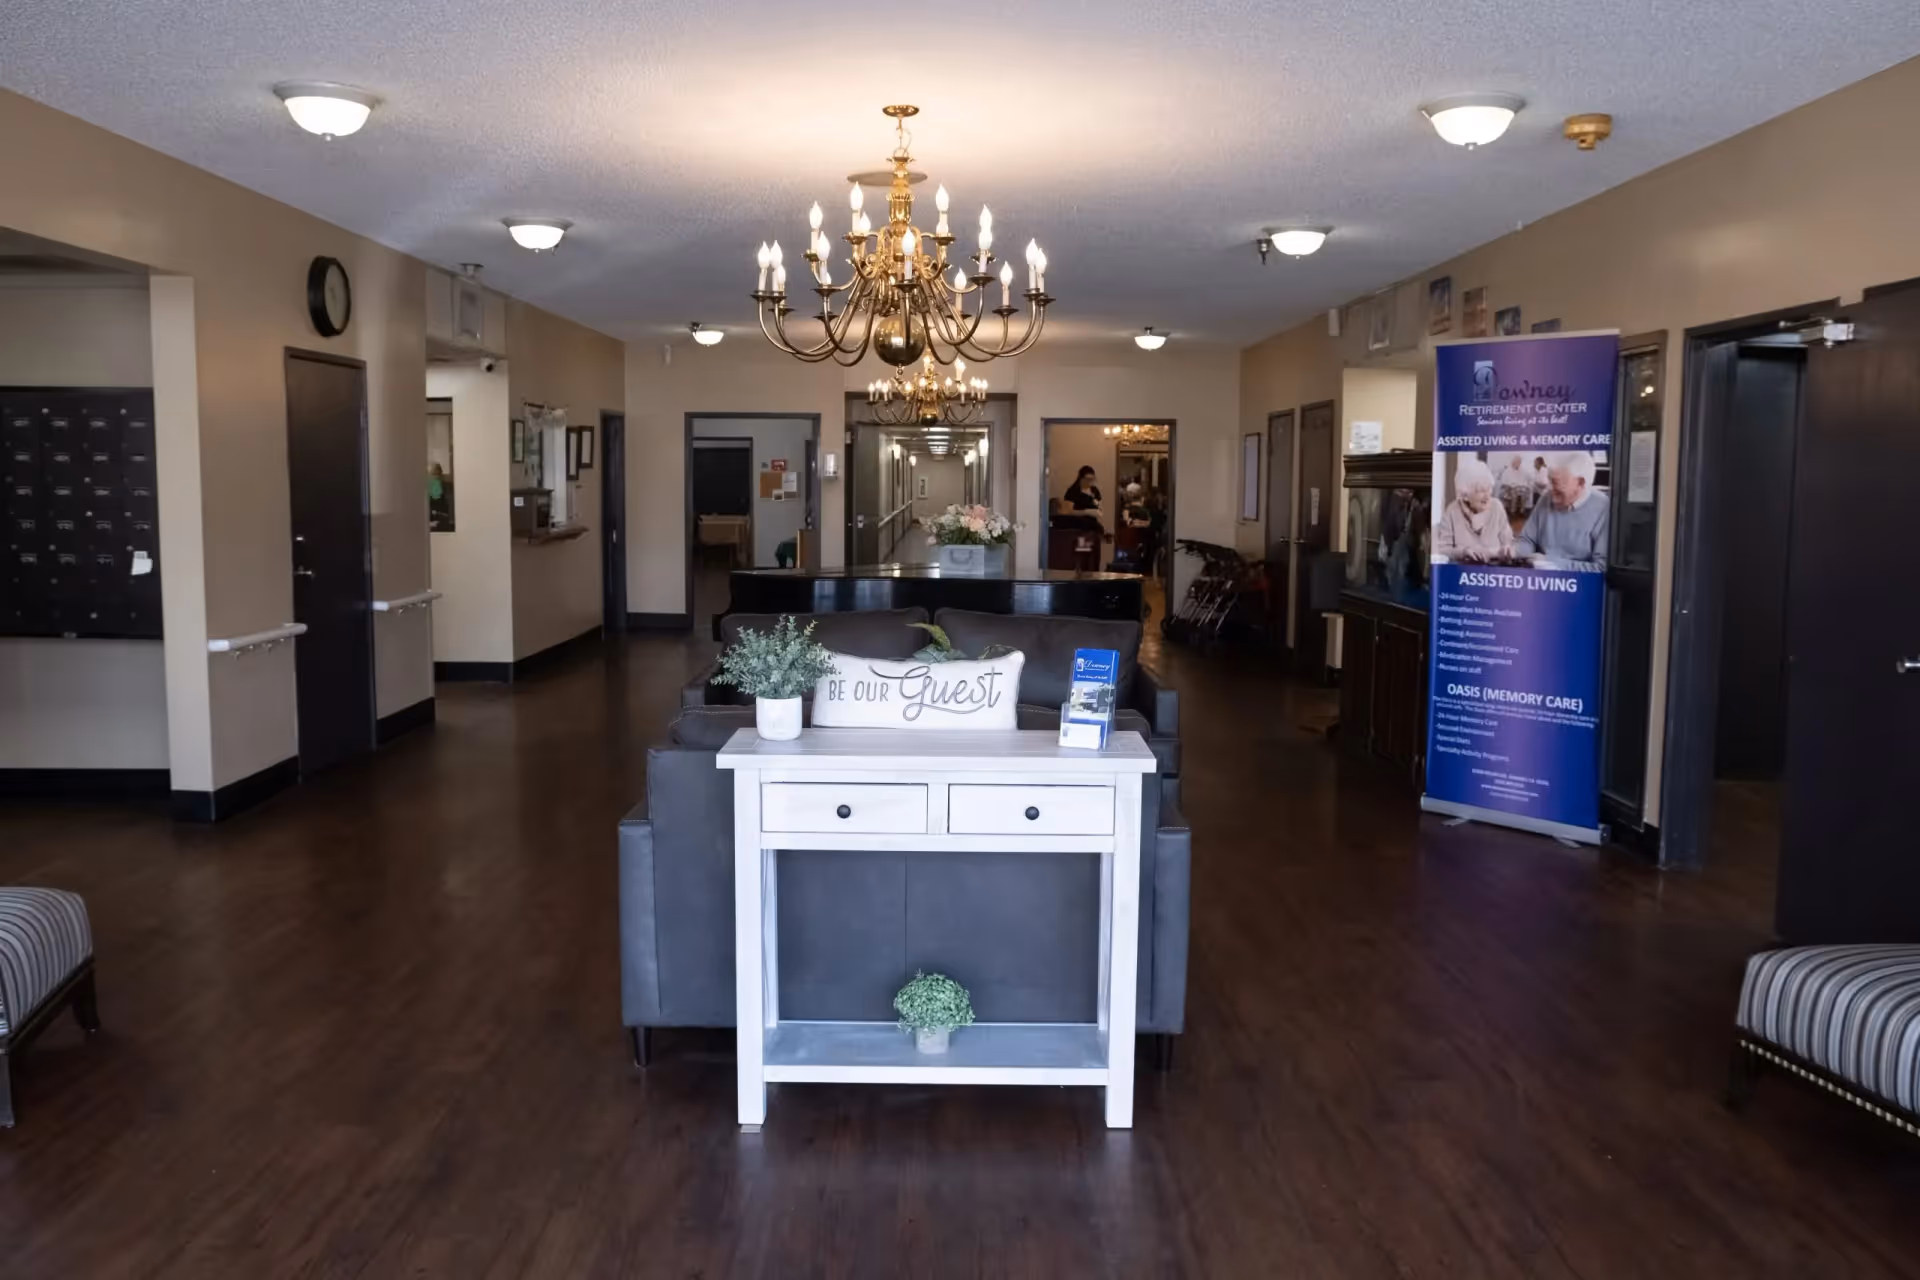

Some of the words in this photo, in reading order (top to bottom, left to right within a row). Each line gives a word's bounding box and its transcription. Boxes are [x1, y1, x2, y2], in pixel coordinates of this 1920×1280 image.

[1459, 403, 1532, 416] RETIREMENT
[1535, 402, 1588, 414] CENTER
[1437, 436, 1482, 447] ASSISTED
[1483, 435, 1518, 446] LIVING
[1519, 435, 1528, 446] &
[1530, 434, 1580, 446] MEMORY
[1582, 434, 1612, 445] CARE
[1459, 572, 1524, 589] ASSISTED
[1527, 576, 1578, 593] LIVING
[828, 680, 846, 701] BE
[853, 681, 889, 702] OUR
[869, 665, 1003, 721] Guest
[1447, 683, 1481, 698] OASIS
[1483, 686, 1544, 706] (MEMORY
[1545, 696, 1584, 714] CARE)
